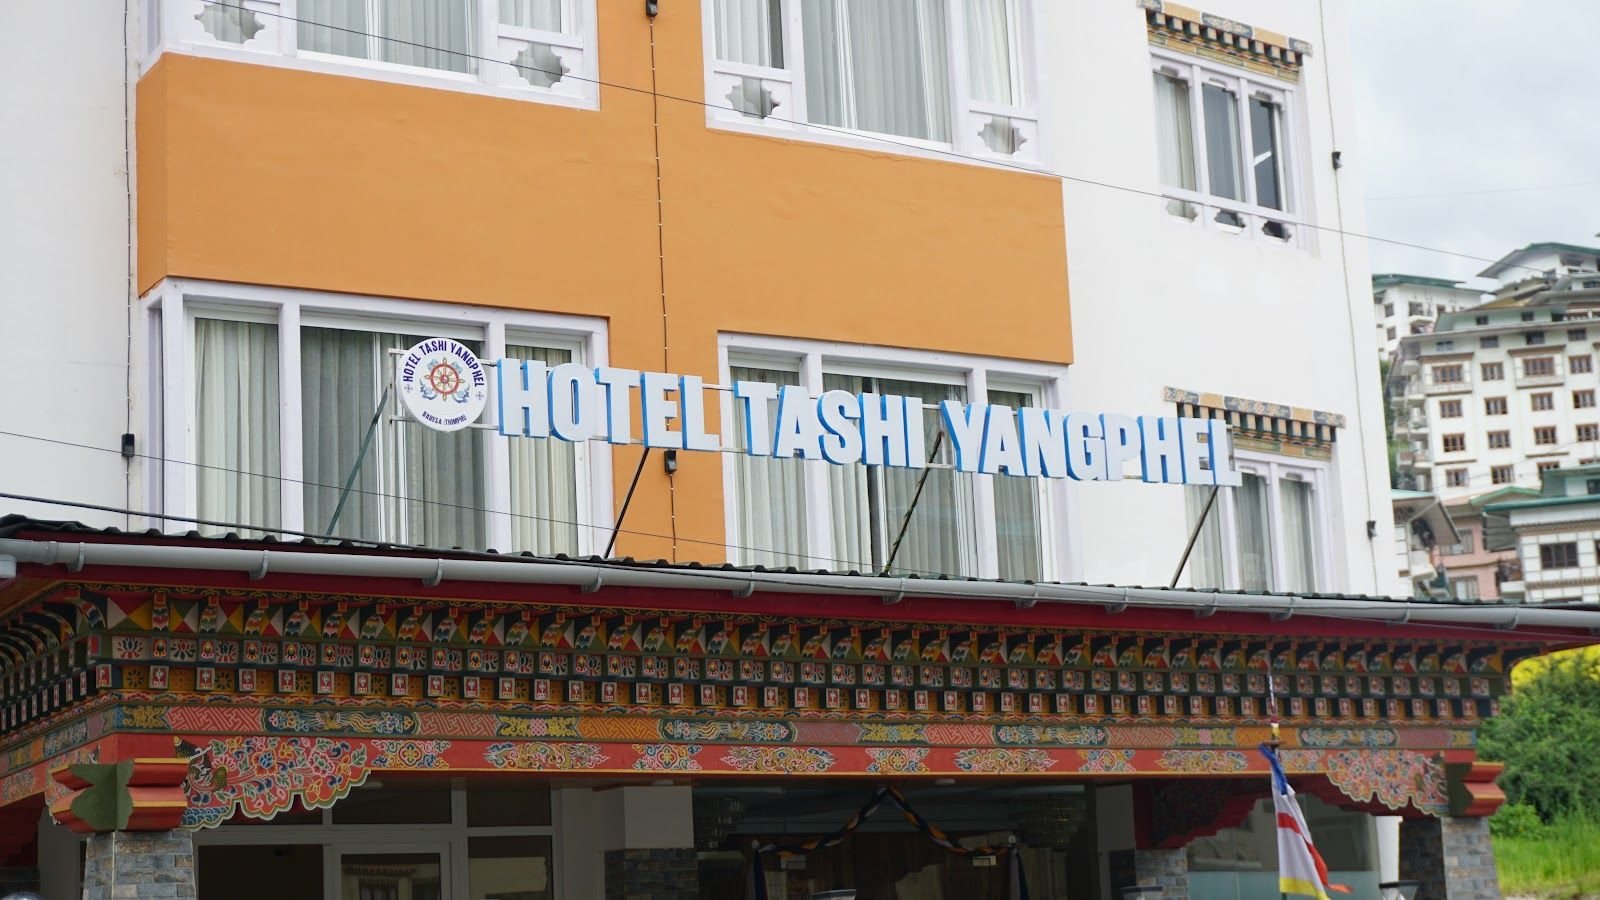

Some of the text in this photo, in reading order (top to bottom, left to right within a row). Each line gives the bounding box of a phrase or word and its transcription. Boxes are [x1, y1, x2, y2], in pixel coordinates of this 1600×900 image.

[403, 340, 484, 387] HOTEL TASHI YANGPHEL
[497, 358, 1242, 487] HOTEL TASHI YANGPHEL
